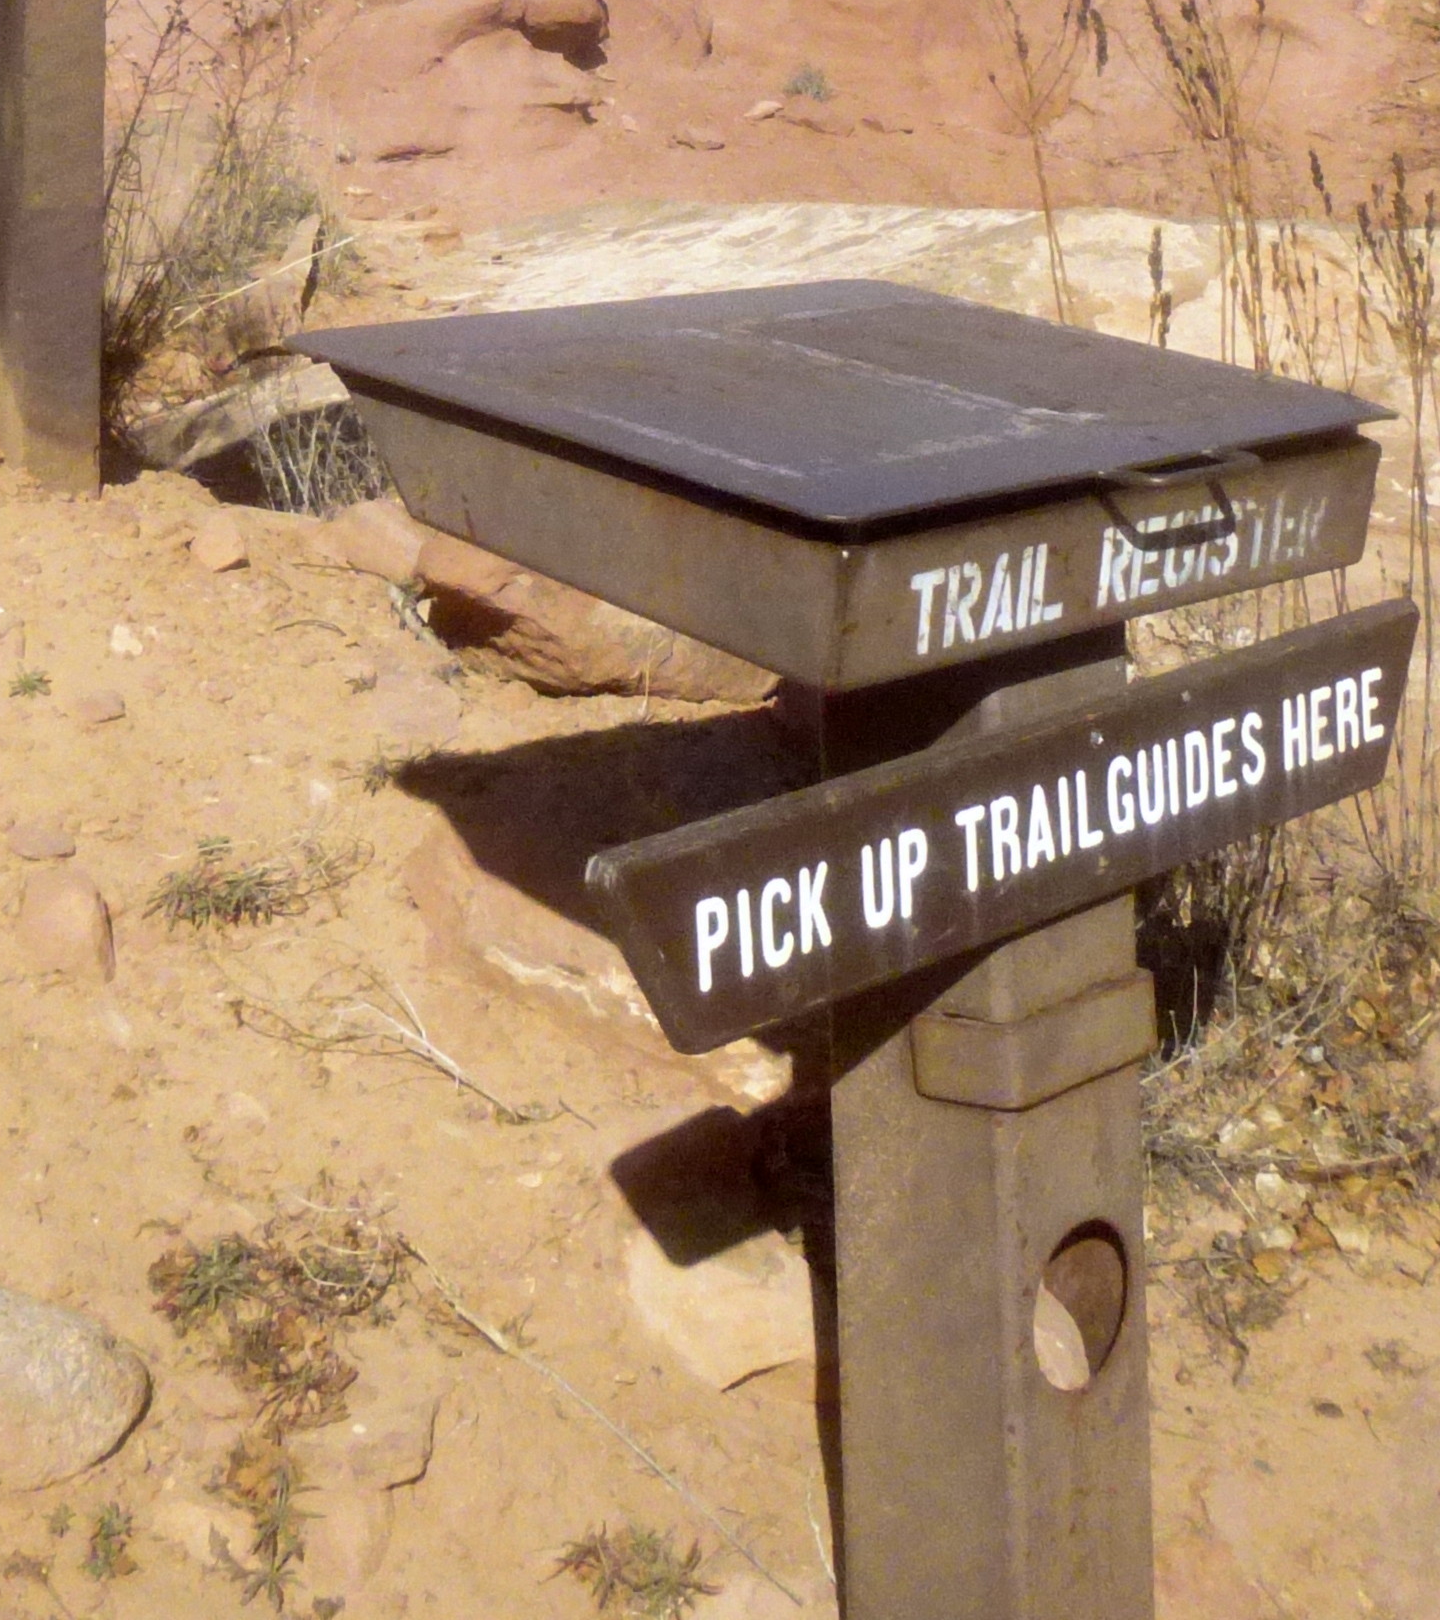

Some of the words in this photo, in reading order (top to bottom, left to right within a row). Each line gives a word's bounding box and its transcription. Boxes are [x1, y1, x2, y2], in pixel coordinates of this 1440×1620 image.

[910, 542, 1064, 656] TRAIL
[1096, 493, 1329, 609] REGISTER
[696, 861, 832, 993] PICK
[861, 828, 928, 929] UP
[1283, 667, 1385, 773] HERE
